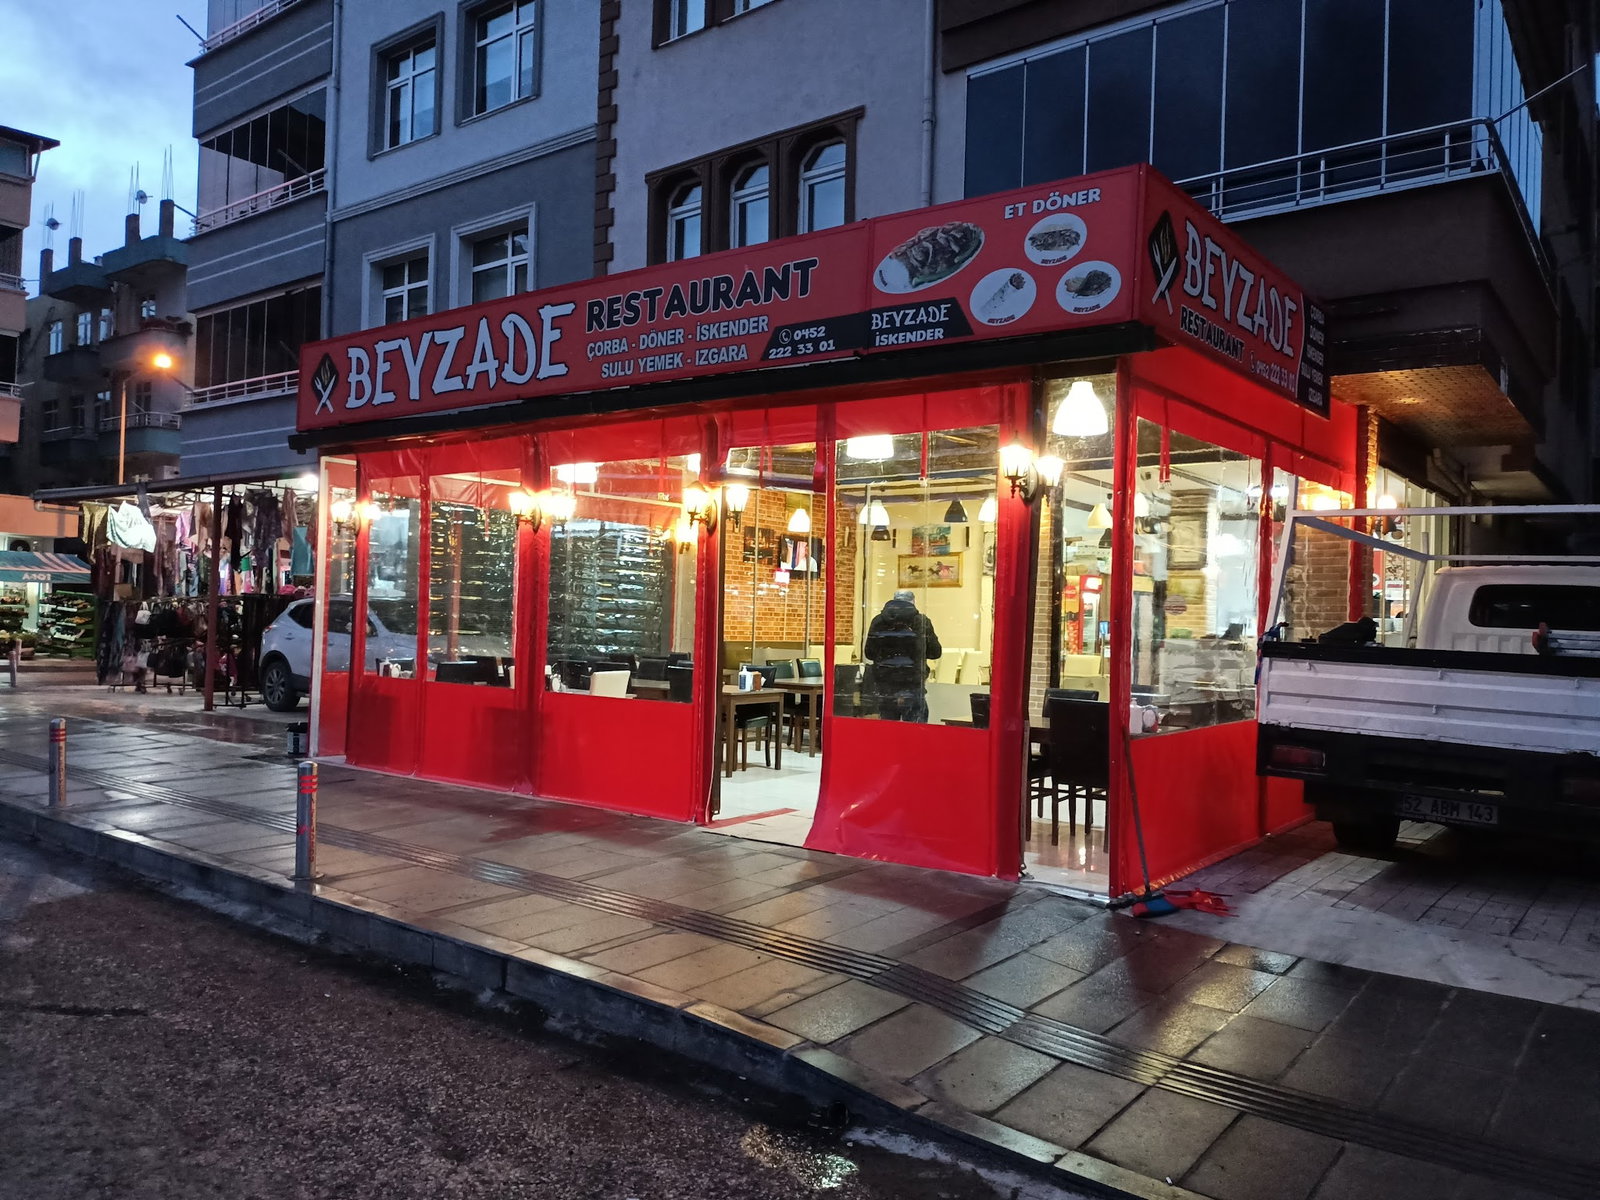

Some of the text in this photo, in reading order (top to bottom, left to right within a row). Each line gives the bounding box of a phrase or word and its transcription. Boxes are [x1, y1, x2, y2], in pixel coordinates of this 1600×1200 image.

[1004, 188, 1101, 220] ET DÖNER
[585, 257, 819, 333] RESTAURANT
[1183, 220, 1298, 357] BEYZADE
[793, 326, 827, 341] 0452
[871, 304, 952, 330] BEYZADE
[1180, 304, 1245, 363] RESTAURANT
[586, 338, 628, 361] ÇORBA
[639, 329, 685, 350] DÖNER
[696, 315, 769, 342] İSKENDER
[768, 339, 836, 359] 222 33 01
[875, 327, 944, 347] İSKENDER
[345, 302, 576, 409] BEYZADE
[601, 359, 634, 379] SULU
[638, 352, 684, 374] YEMEK
[695, 344, 748, 366] IZGARA
[1404, 797, 1493, 822] 52 ABM 143
